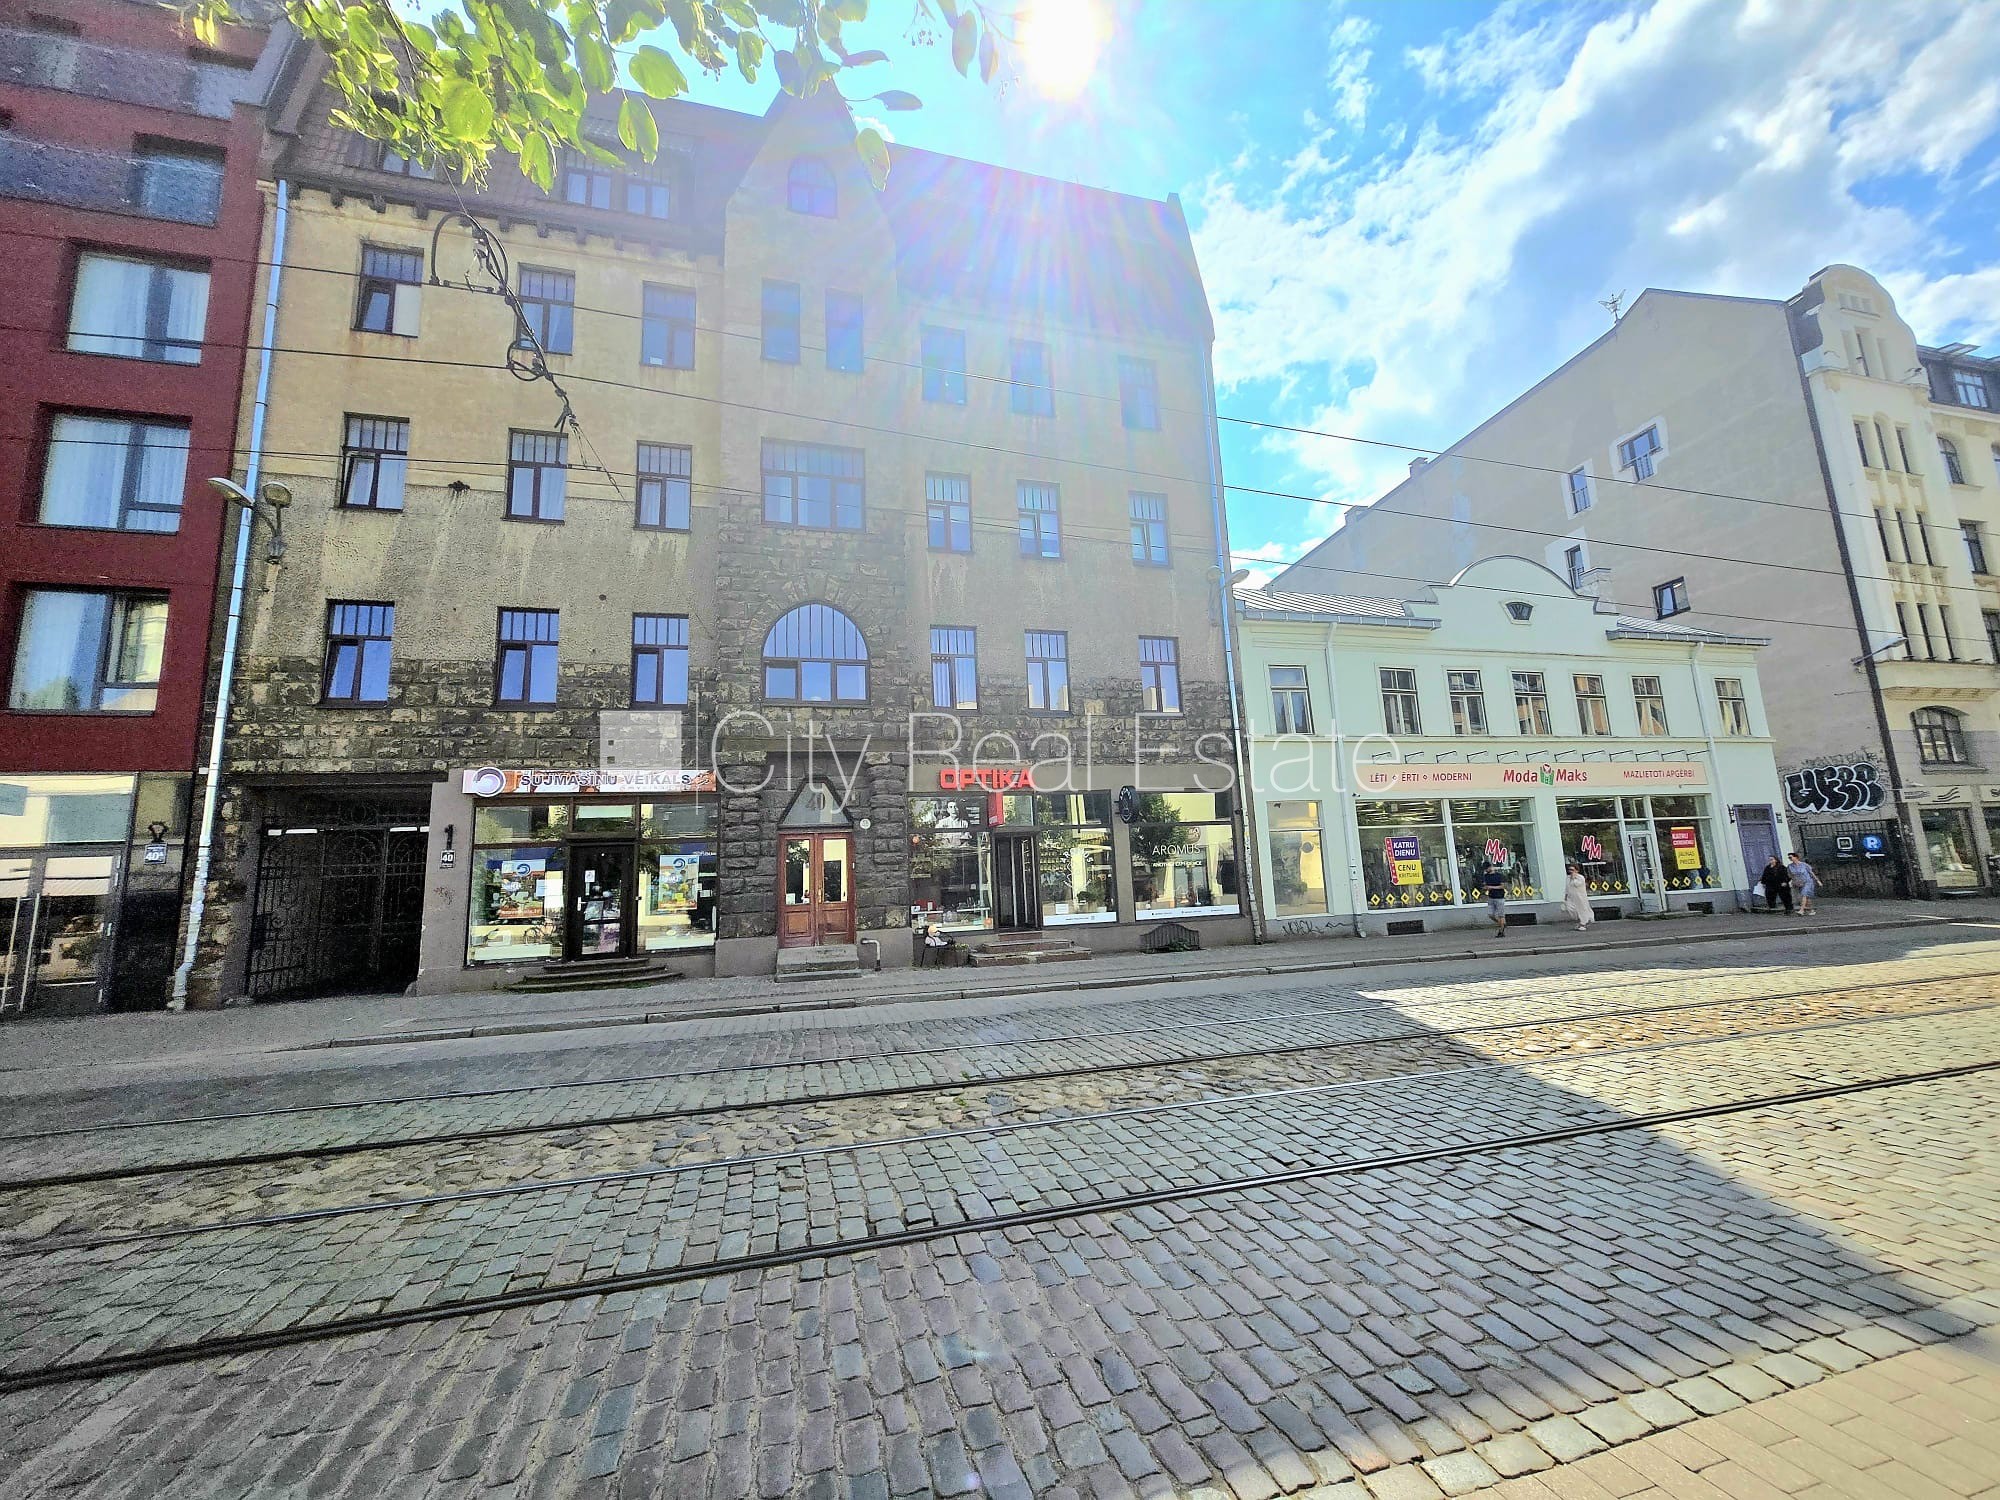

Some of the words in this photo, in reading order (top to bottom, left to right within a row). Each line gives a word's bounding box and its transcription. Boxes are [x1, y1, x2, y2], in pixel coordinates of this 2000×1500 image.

[624, 772, 691, 785] VEIKALS
[940, 768, 1033, 790] OPTIKA
[1432, 772, 1472, 782] MODERNI
[1503, 769, 1538, 783] Moda
[1556, 768, 1588, 782] Maks
[1151, 844, 1202, 856] AROMUS
[1393, 841, 1415, 849] KATRU
[442, 854, 454, 862] 40
[1394, 849, 1416, 857] DIENU
[1397, 864, 1417, 872] CENU
